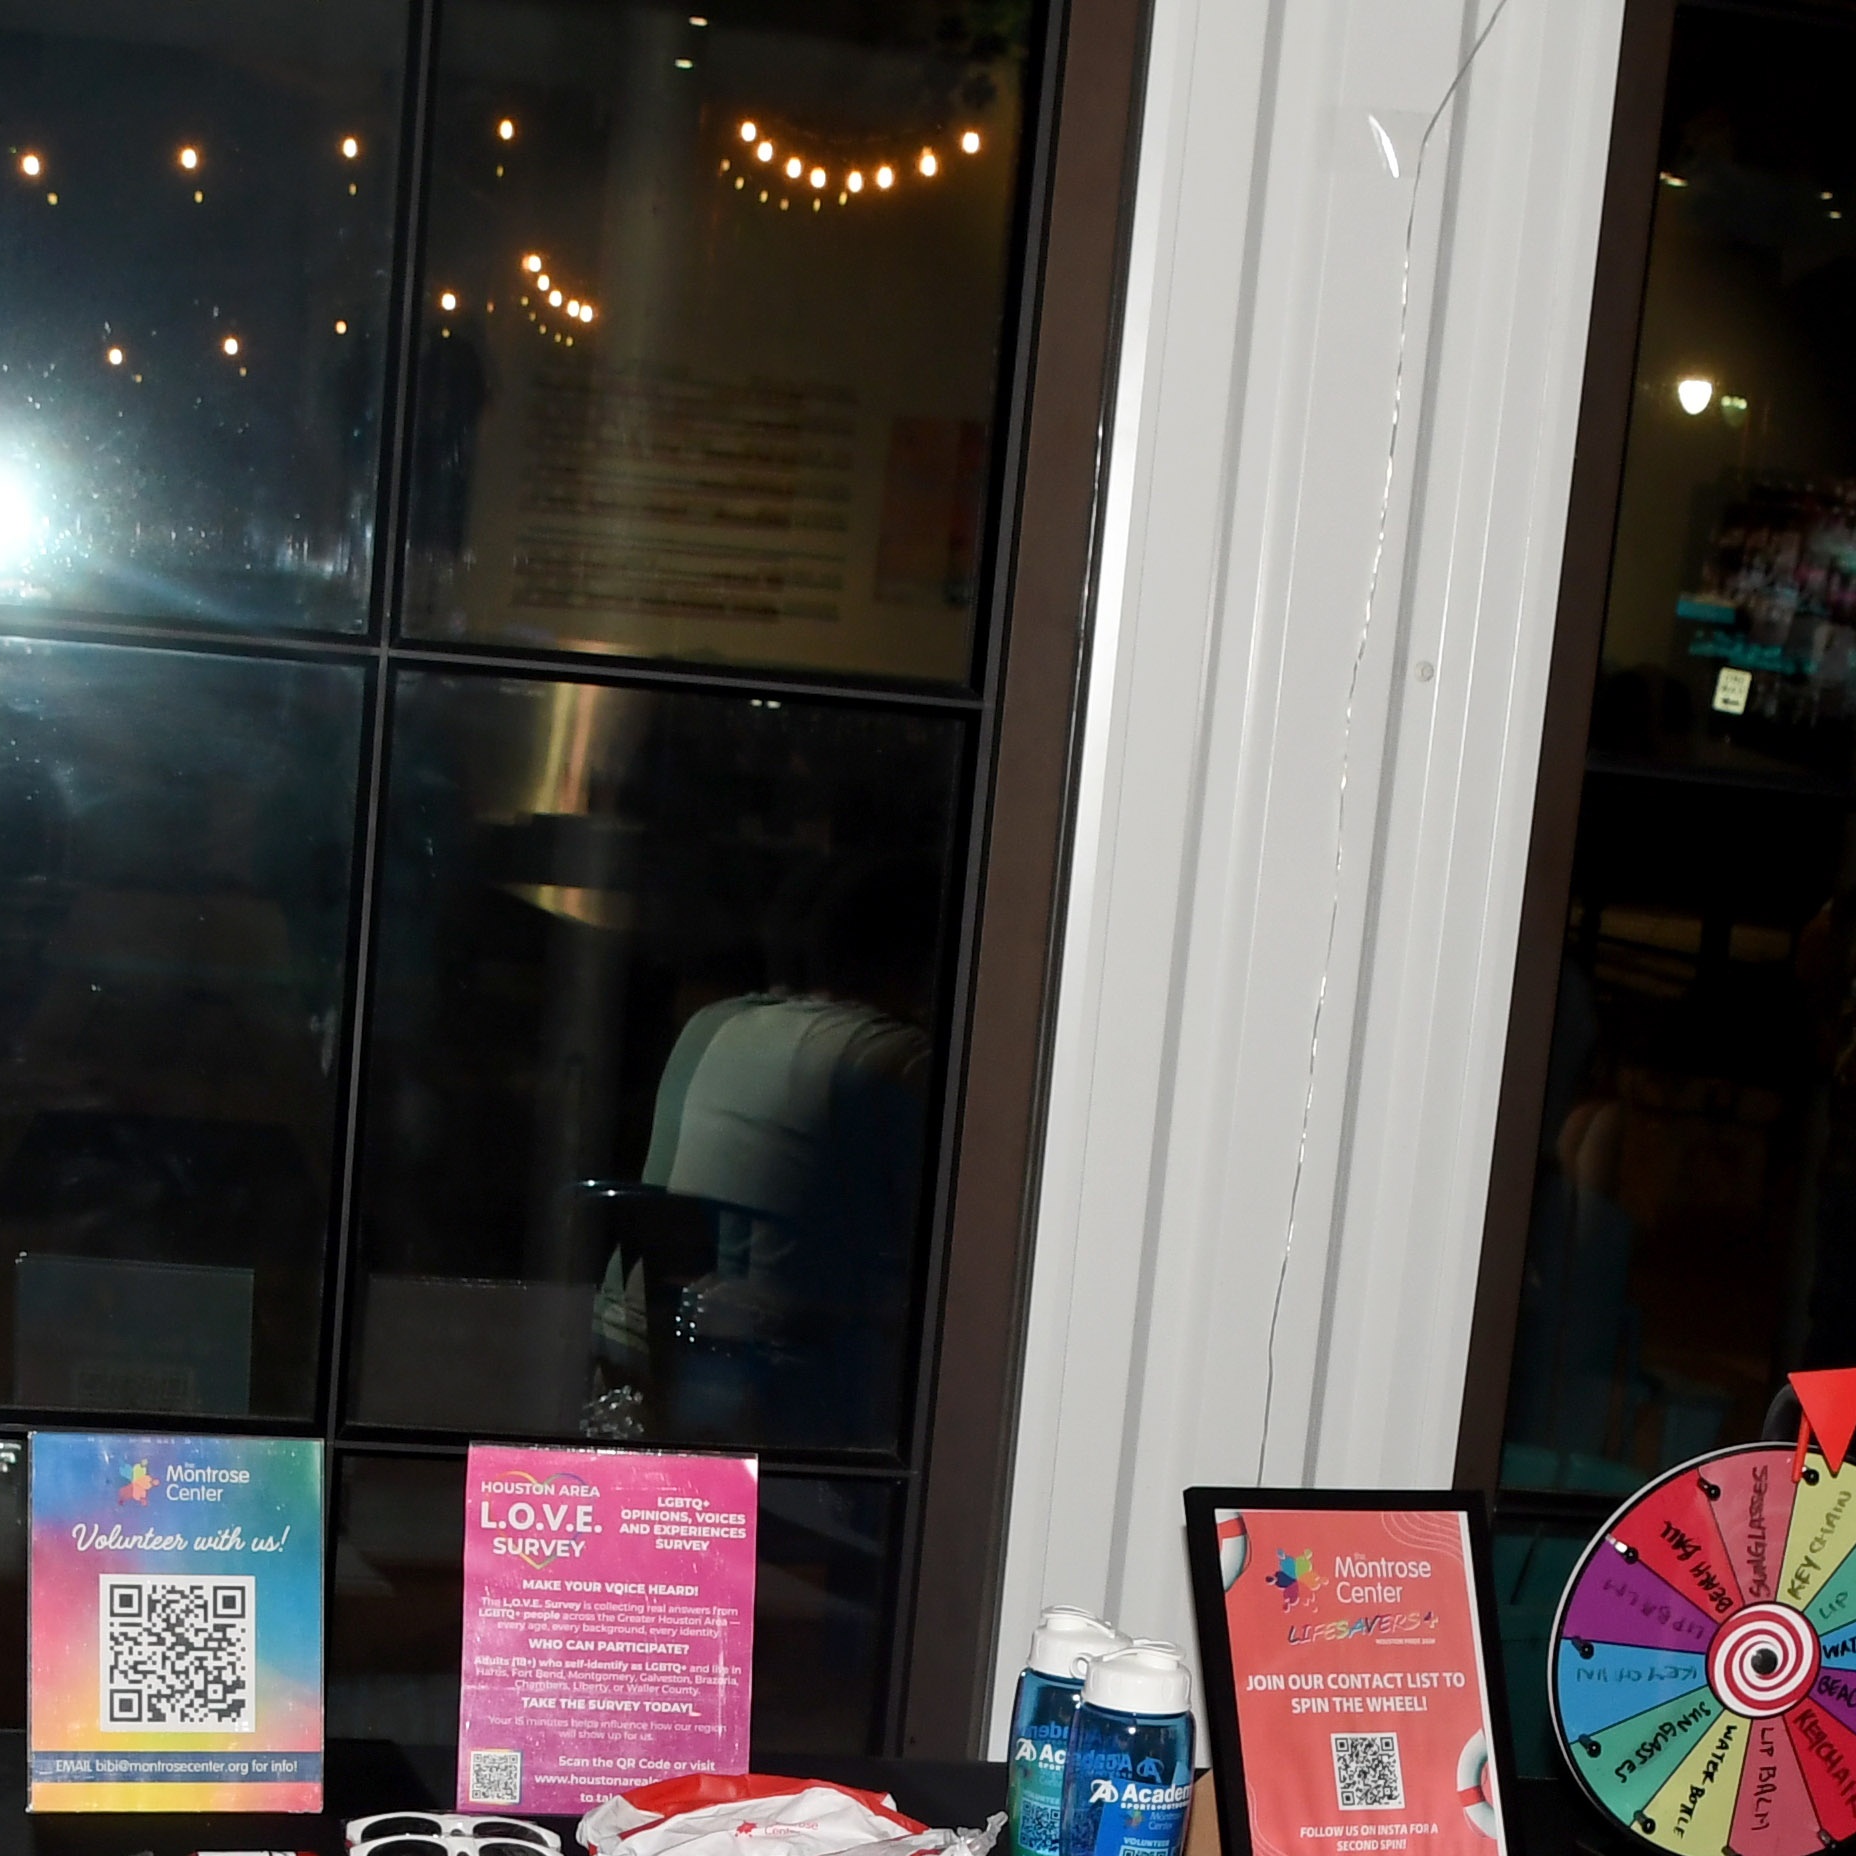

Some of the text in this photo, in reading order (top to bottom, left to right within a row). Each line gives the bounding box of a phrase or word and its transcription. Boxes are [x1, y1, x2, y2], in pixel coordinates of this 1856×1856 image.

[166, 1464, 250, 1484] Montrose
[166, 1484, 224, 1502] Center
[480, 1481, 600, 1498] HOUSTON AREA
[657, 1496, 711, 1509] LGBTQ+
[480, 1501, 603, 1534] L.O.V.E.
[620, 1508, 746, 1525] OPINIONS, VOICES
[71, 1523, 291, 1552] Volunteer with us!
[619, 1523, 747, 1539] AND EXPERIENCES
[1748, 1464, 1771, 1598] SUNGLASSES
[493, 1537, 585, 1558] SURVEY
[655, 1538, 710, 1551] SURVEY
[1334, 1556, 1432, 1578] Montrose
[522, 1579, 699, 1597] MAKE YOUR VOICE HEARD!
[1336, 1581, 1403, 1604] Center
[544, 1599, 582, 1611] Survey
[594, 1601, 644, 1614] collecting
[668, 1605, 711, 1615] answers
[712, 1606, 738, 1616] from
[1819, 1591, 1849, 1620] LIP
[478, 1608, 521, 1620] LGBTQ+
[523, 1610, 561, 1621] people
[562, 1612, 596, 1622] across
[597, 1612, 616, 1622] the
[617, 1613, 656, 1624] Greater
[658, 1614, 702, 1625] Houston
[497, 1621, 526, 1632] every
[552, 1623, 580, 1634] every
[582, 1623, 647, 1635] background,
[649, 1626, 678, 1637] every
[528, 1638, 690, 1655] WHO CAN PARTICIPATE?
[538, 1658, 562, 1668] who
[564, 1659, 629, 1673] self-identify
[645, 1661, 687, 1674] LGBTQ+
[689, 1663, 710, 1674] and
[731, 1665, 742, 1675] in
[511, 1668, 533, 1678] Fort
[535, 1668, 566, 1680] Bend,
[568, 1670, 637, 1684] Montgomery,
[639, 1673, 693, 1685] Galveston,
[1246, 1672, 1465, 1691] JOIN OUR CONTACT LIST TO
[613, 1684, 624, 1693] or
[626, 1684, 660, 1694] Waller
[522, 1697, 695, 1714] TAKE THE SURVEY TODAY!
[1292, 1696, 1427, 1714] SPIN THE WHEEL!
[526, 1717, 569, 1728] minutes
[600, 1720, 649, 1730] influence
[650, 1721, 672, 1731] how
[674, 1723, 692, 1732] our
[694, 1723, 727, 1735] region
[607, 1731, 621, 1741] up
[558, 1755, 716, 1771] Scan the QR Code or visit
[1702, 1723, 1738, 1787] WATER
[55, 1759, 93, 1773] EMAIL
[251, 1760, 268, 1773] for
[270, 1760, 298, 1773] info!
[1749, 1726, 1778, 1833] LIP BALM
[580, 1792, 594, 1803] to
[1300, 1823, 1439, 1838] FOLLOW US ON INSTA FOR A
[1337, 1839, 1406, 1852] SECOND SPIN!
